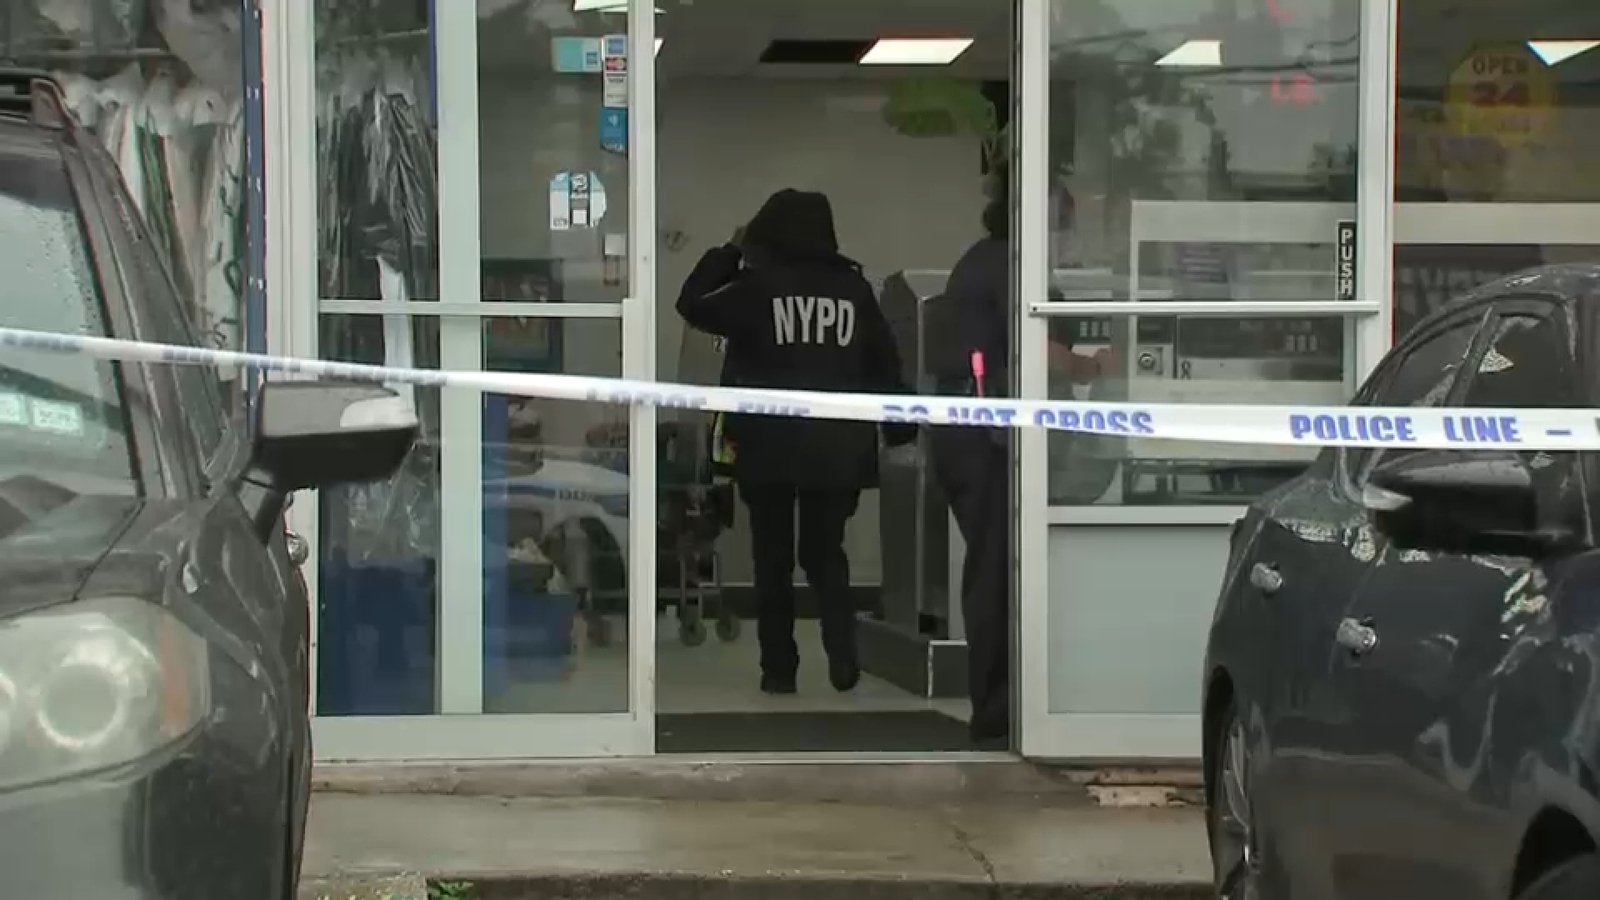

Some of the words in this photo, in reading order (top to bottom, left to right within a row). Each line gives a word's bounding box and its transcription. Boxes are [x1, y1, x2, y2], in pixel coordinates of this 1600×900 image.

[1472, 56, 1528, 75] OPEN
[1341, 229, 1354, 296] PUSH
[773, 296, 855, 347] NYPD
[1034, 408, 1154, 433] CROSS
[1290, 414, 1416, 441] POLICE
[1443, 416, 1522, 442] LINE
